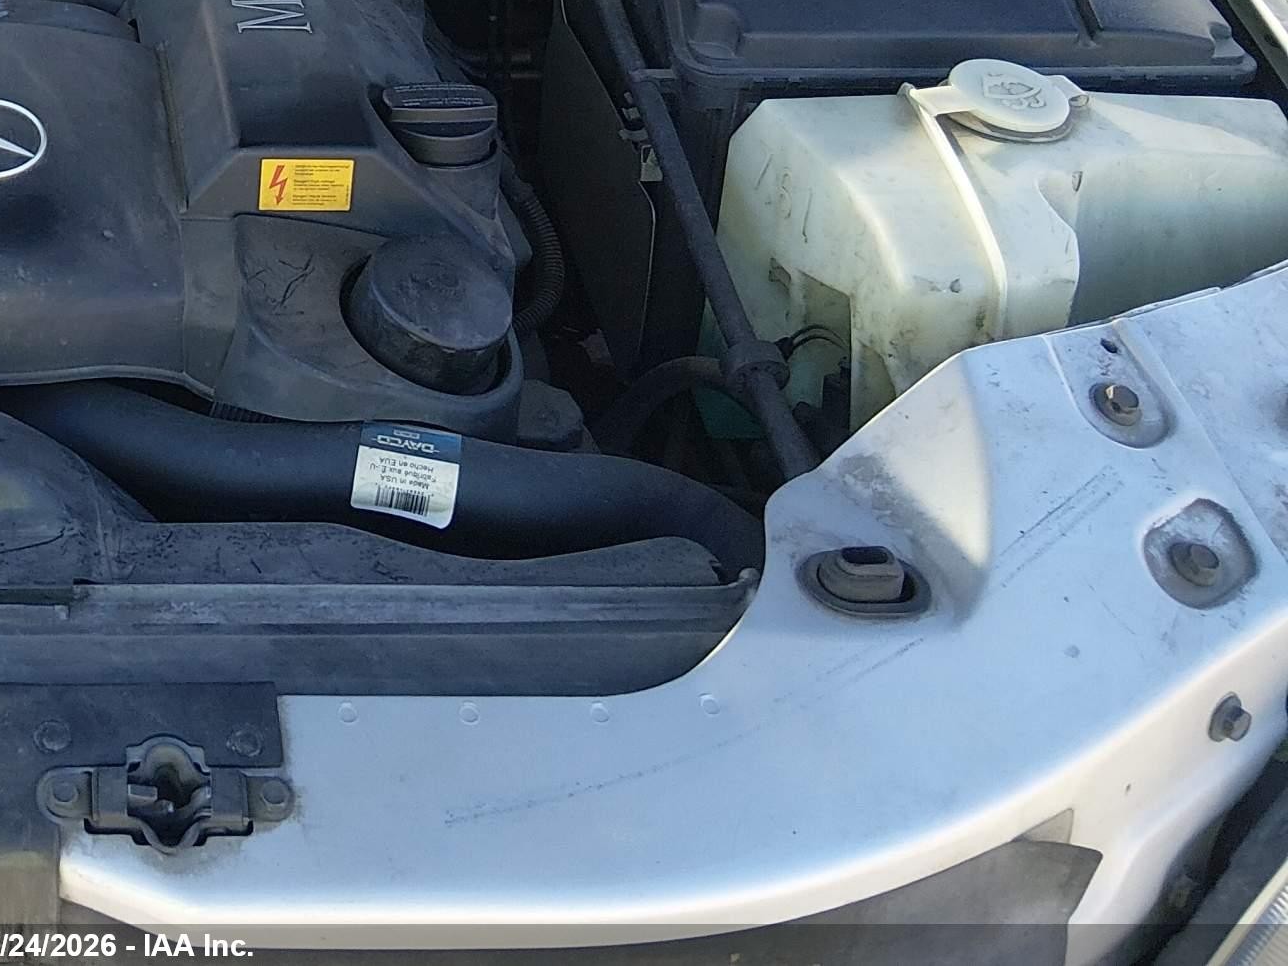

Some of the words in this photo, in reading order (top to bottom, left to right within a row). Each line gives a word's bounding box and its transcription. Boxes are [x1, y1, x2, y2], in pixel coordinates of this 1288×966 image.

[376, 435, 435, 454] DAYCO
[380, 474, 398, 483] USA
[408, 480, 430, 490] Made
